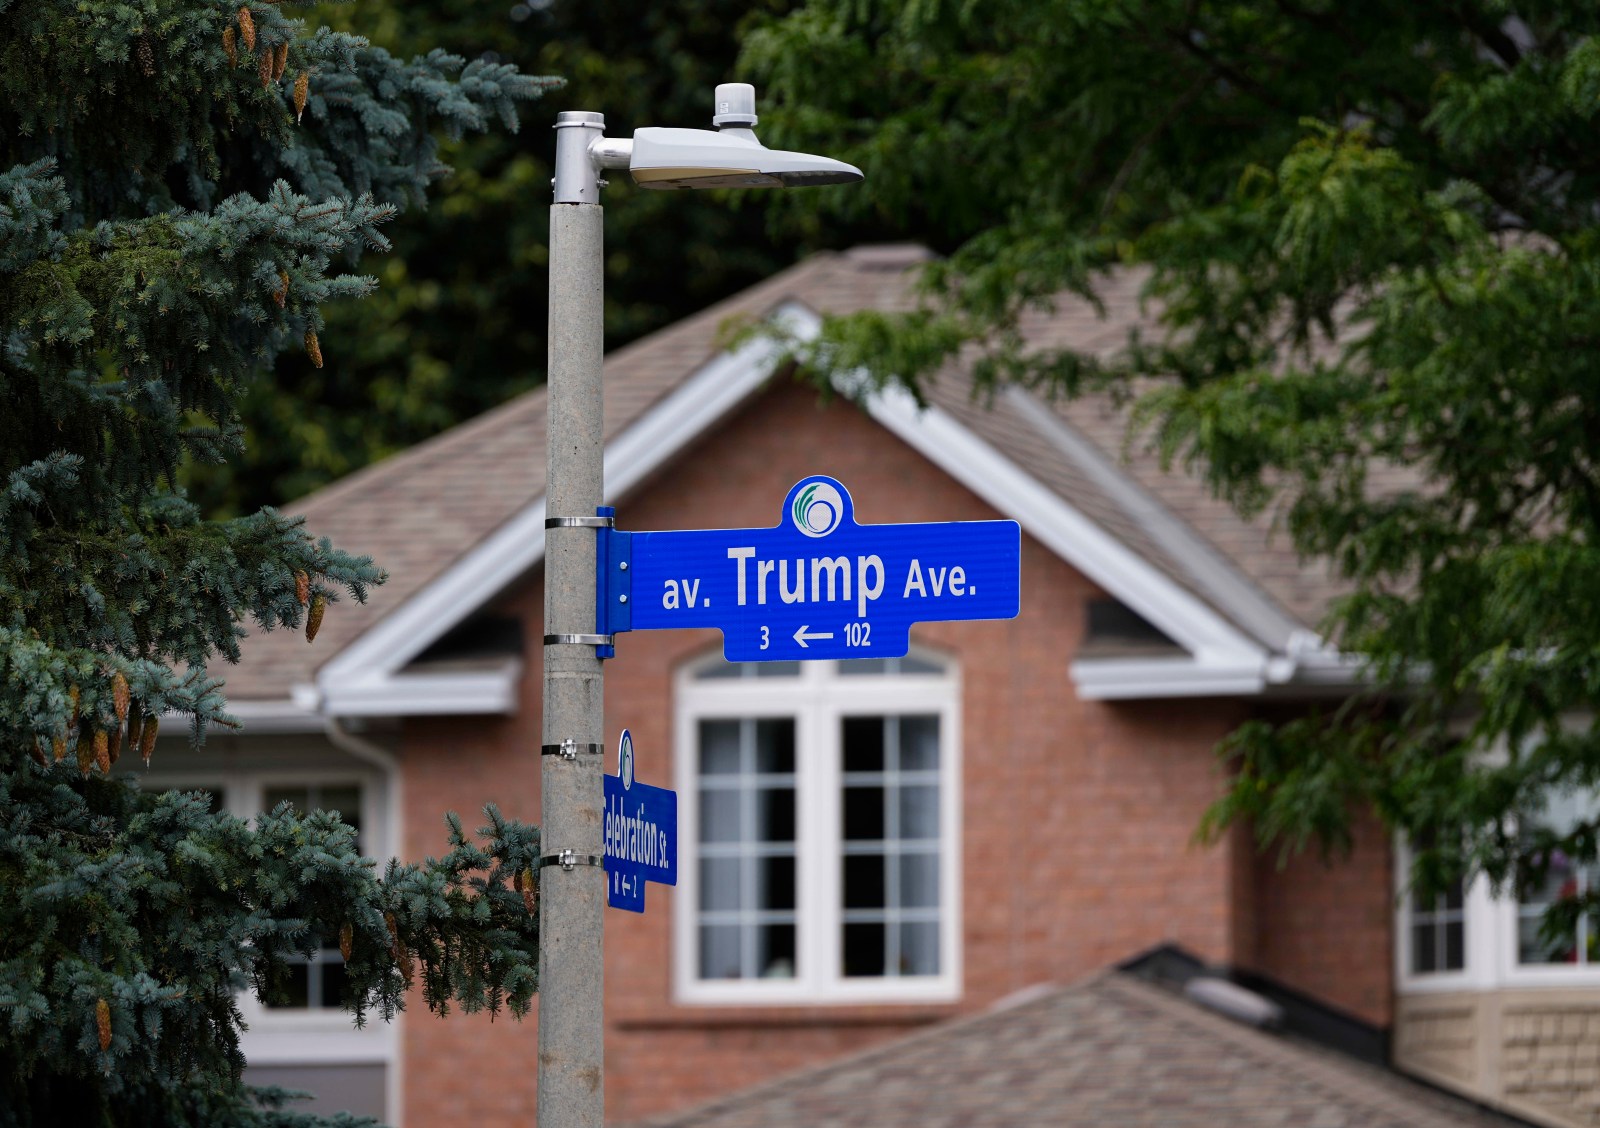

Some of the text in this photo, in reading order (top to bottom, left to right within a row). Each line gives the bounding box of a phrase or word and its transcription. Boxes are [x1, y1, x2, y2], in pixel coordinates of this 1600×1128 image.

[662, 546, 976, 618] av. Trump Ave.
[759, 622, 871, 650] 3 102
